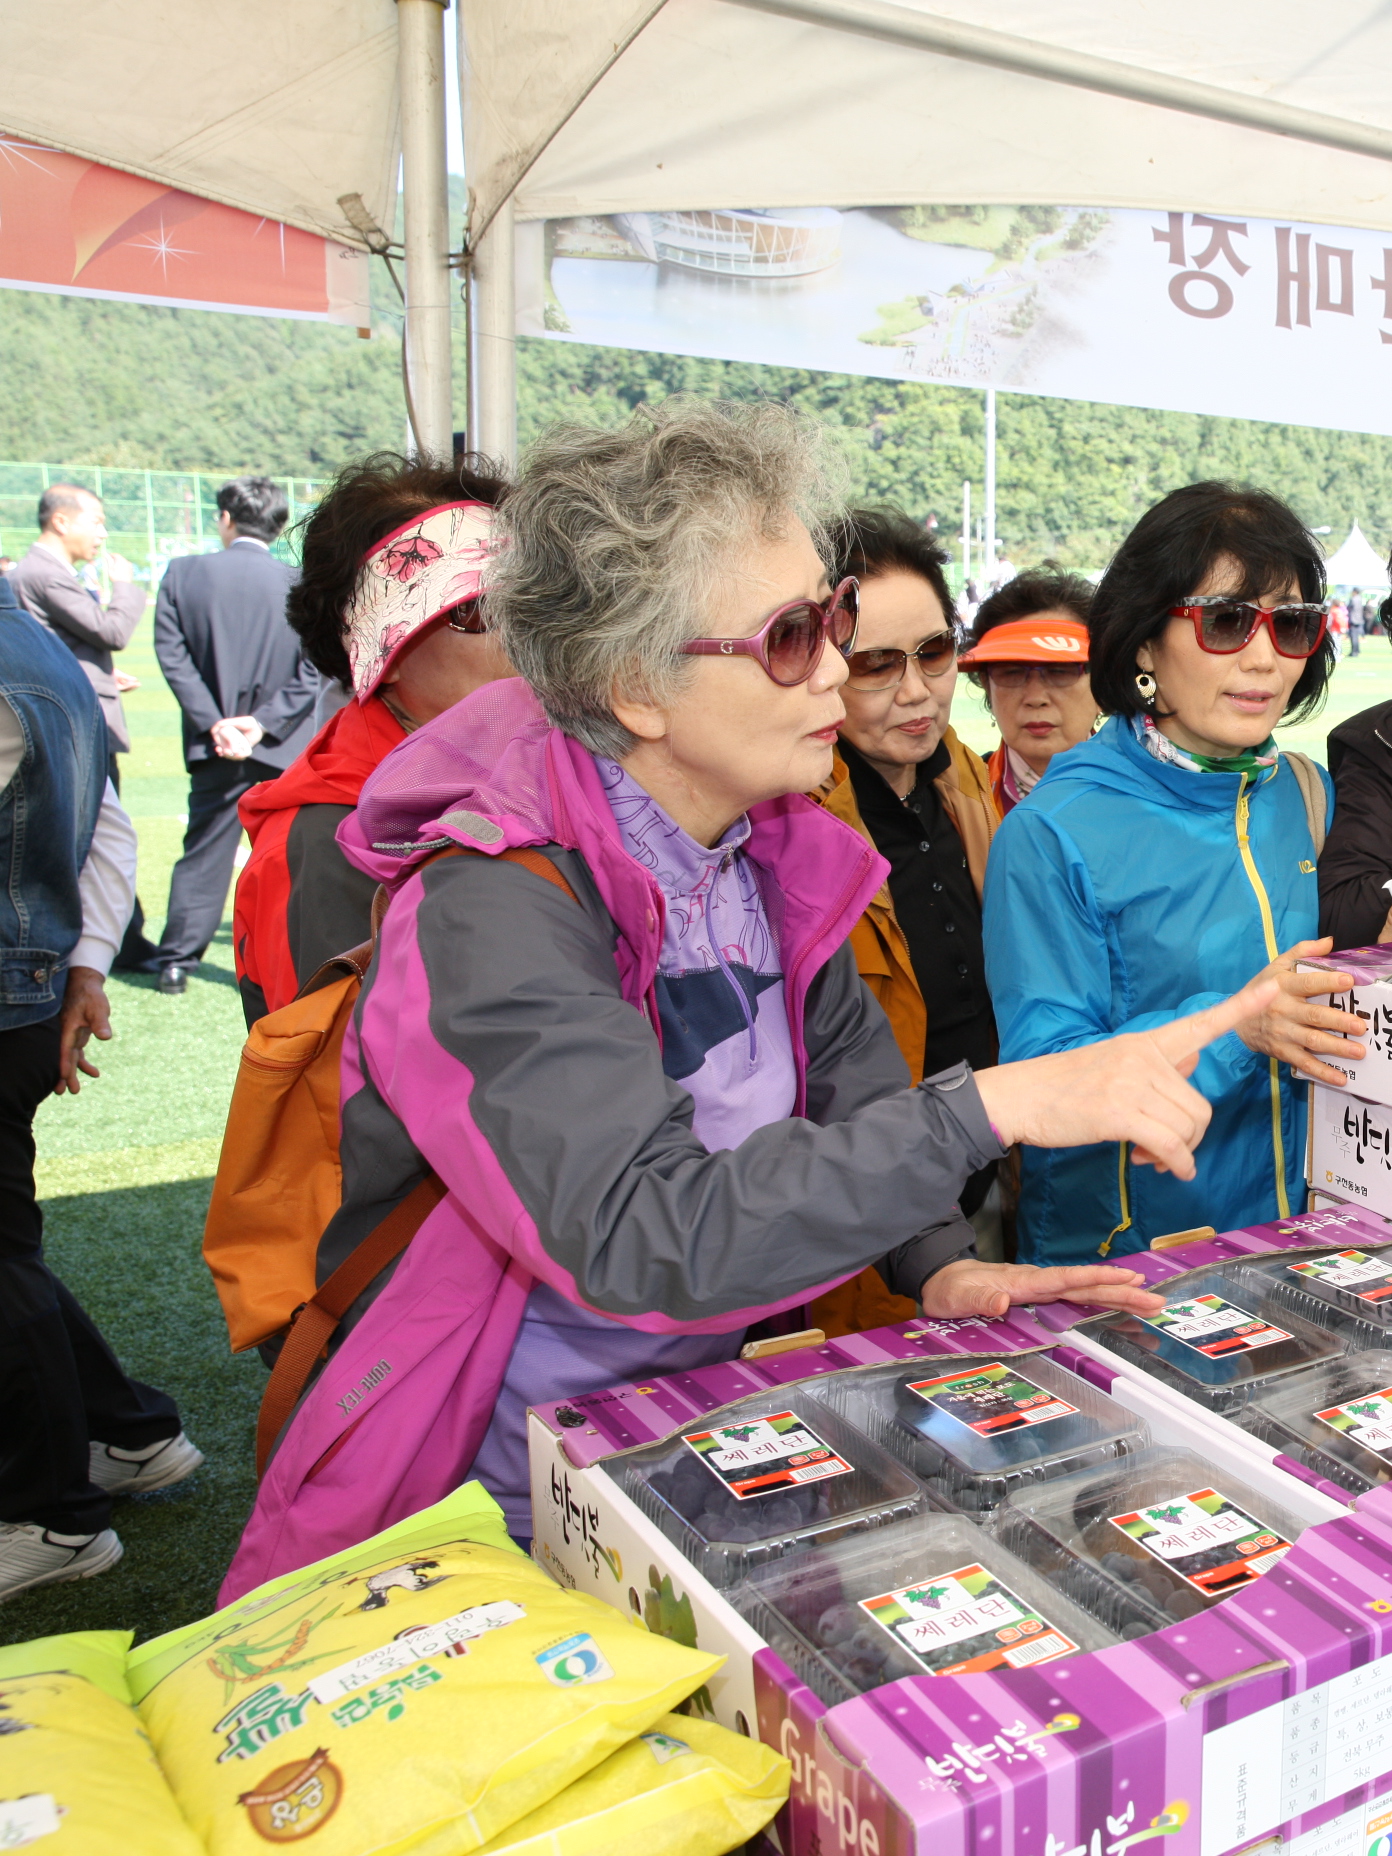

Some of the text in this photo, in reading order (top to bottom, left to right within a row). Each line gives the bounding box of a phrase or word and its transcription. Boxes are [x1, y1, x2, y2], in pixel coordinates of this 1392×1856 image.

[1334, 1174, 1369, 1197] 구천동농협
[336, 1358, 394, 1416] GORE-TEX
[355, 1611, 474, 1669] 011-324-7067
[330, 1663, 444, 1728] 무농약
[1351, 1666, 1382, 1688] 포도
